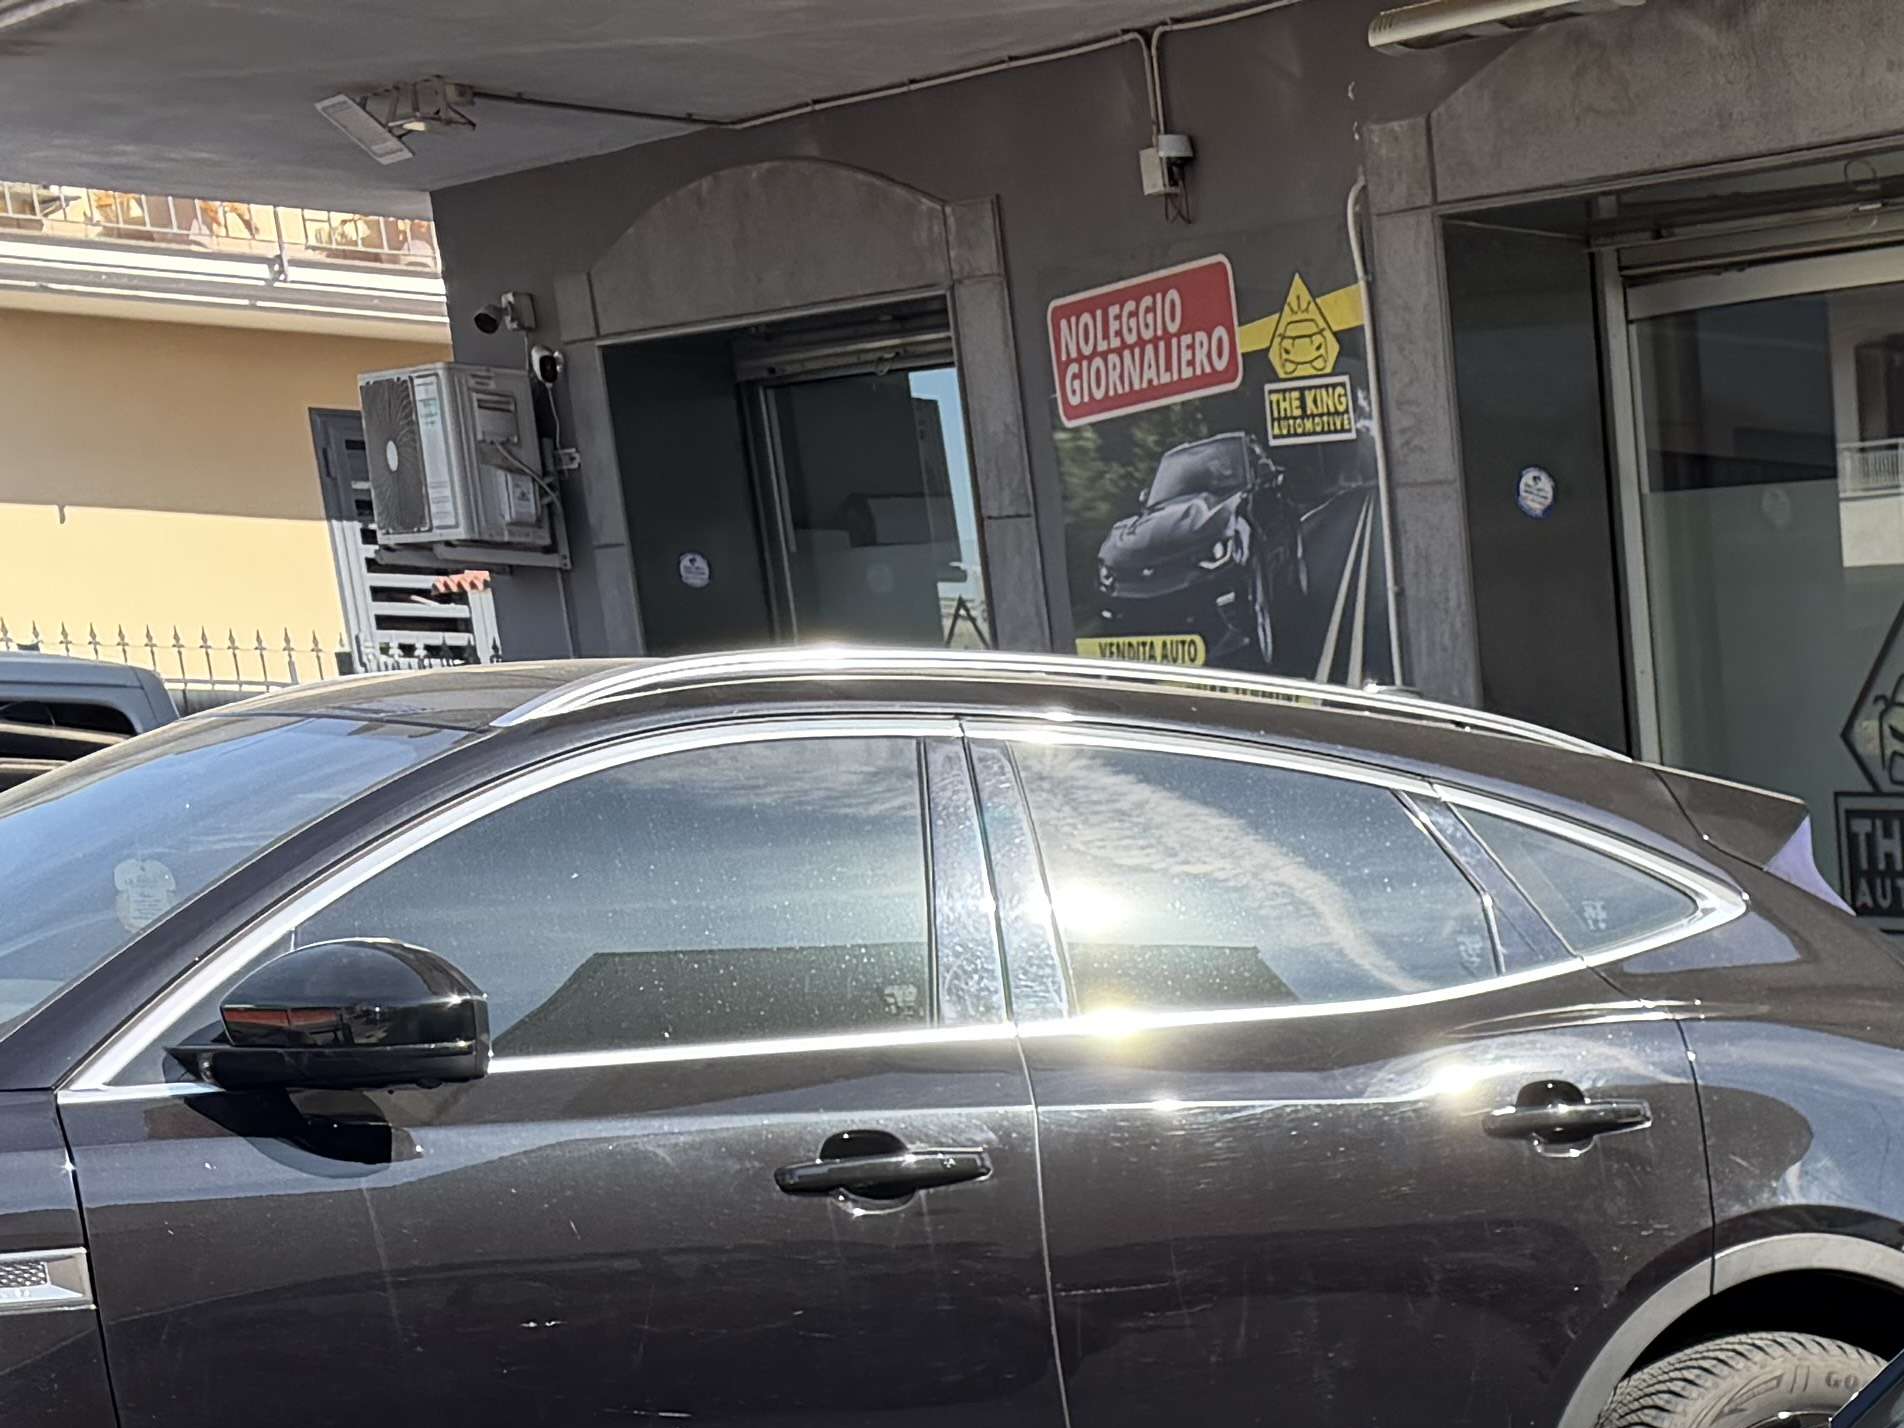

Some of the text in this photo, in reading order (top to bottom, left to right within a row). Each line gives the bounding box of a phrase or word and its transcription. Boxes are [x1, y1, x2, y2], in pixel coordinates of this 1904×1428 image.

[1060, 288, 1182, 361] NOLEGGIO
[1065, 325, 1230, 407] GIORNALIERO
[1270, 385, 1347, 418] THE KING
[1273, 413, 1351, 435] AUTOMOTIVE
[1099, 639, 1198, 663] VENDITA AUTO
